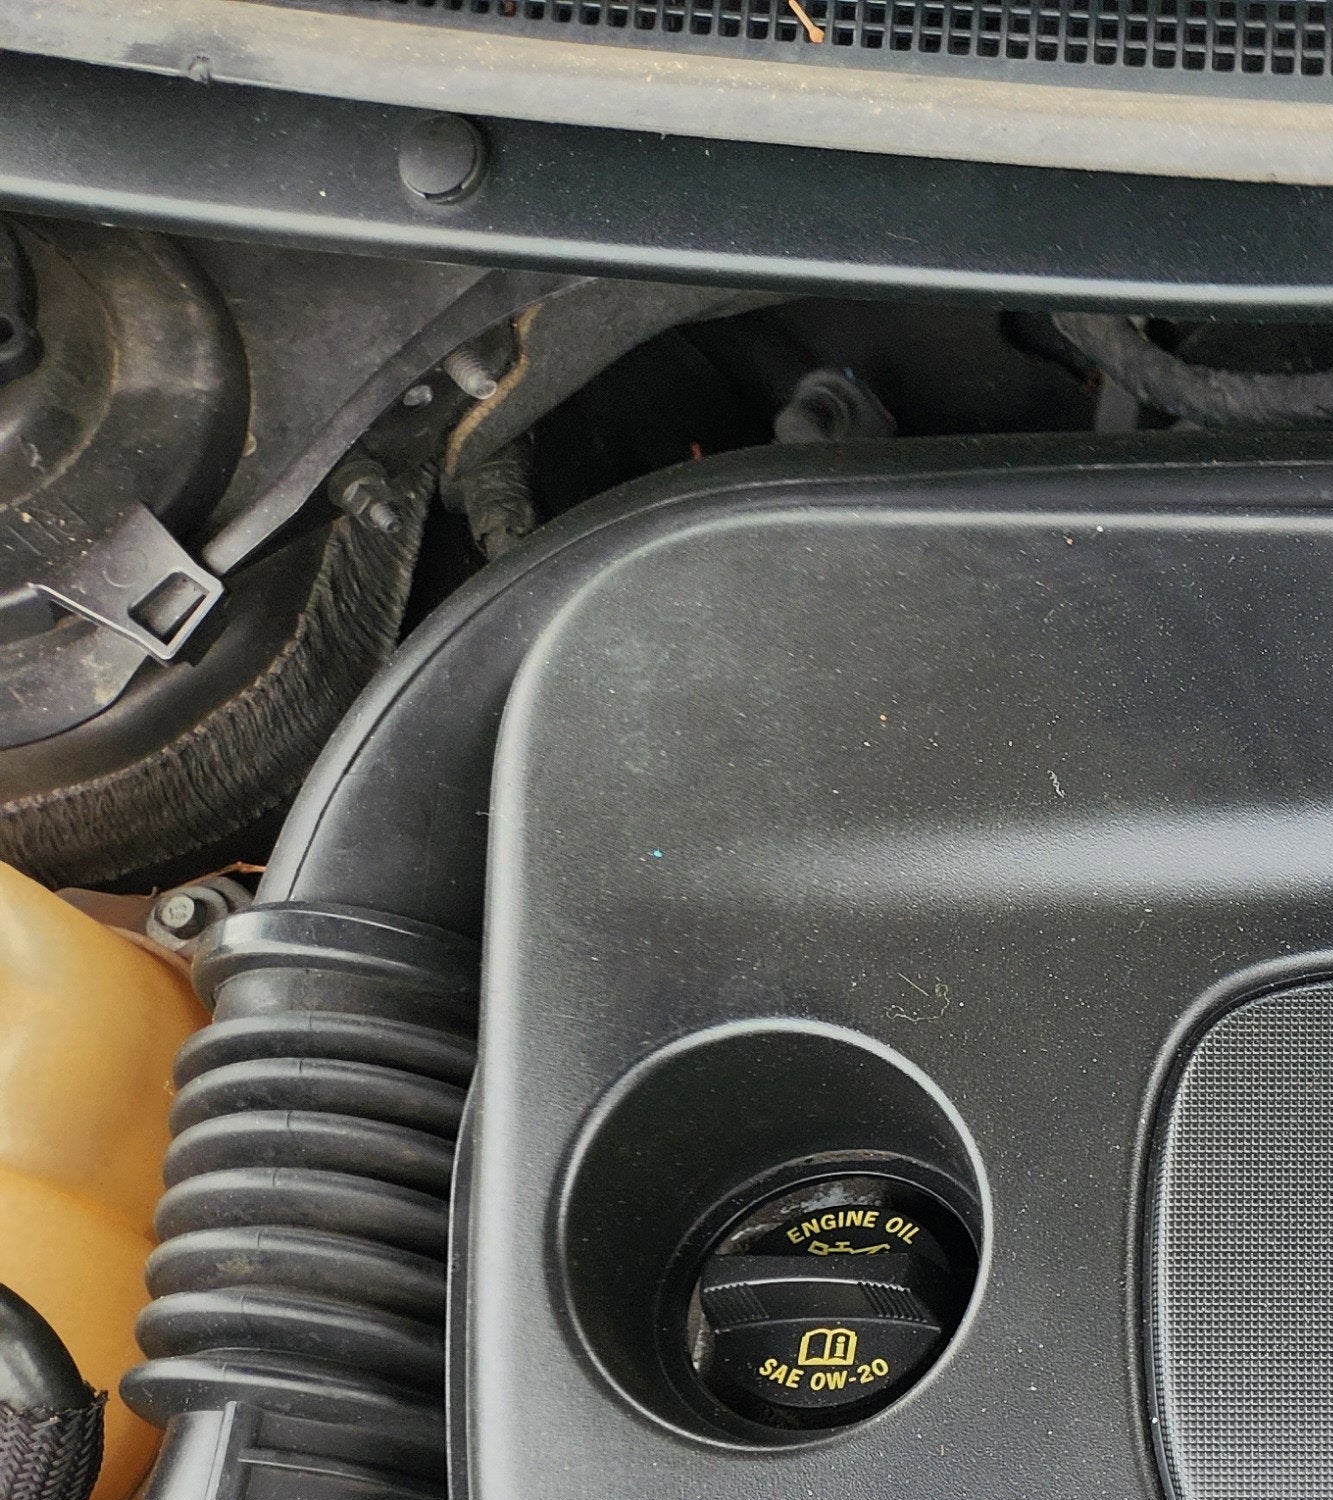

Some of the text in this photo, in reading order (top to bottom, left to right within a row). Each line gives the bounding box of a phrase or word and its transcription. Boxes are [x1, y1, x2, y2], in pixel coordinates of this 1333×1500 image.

[786, 1210, 921, 1246] ENGINE OIL
[758, 1357, 890, 1392] SAE 0W-20
